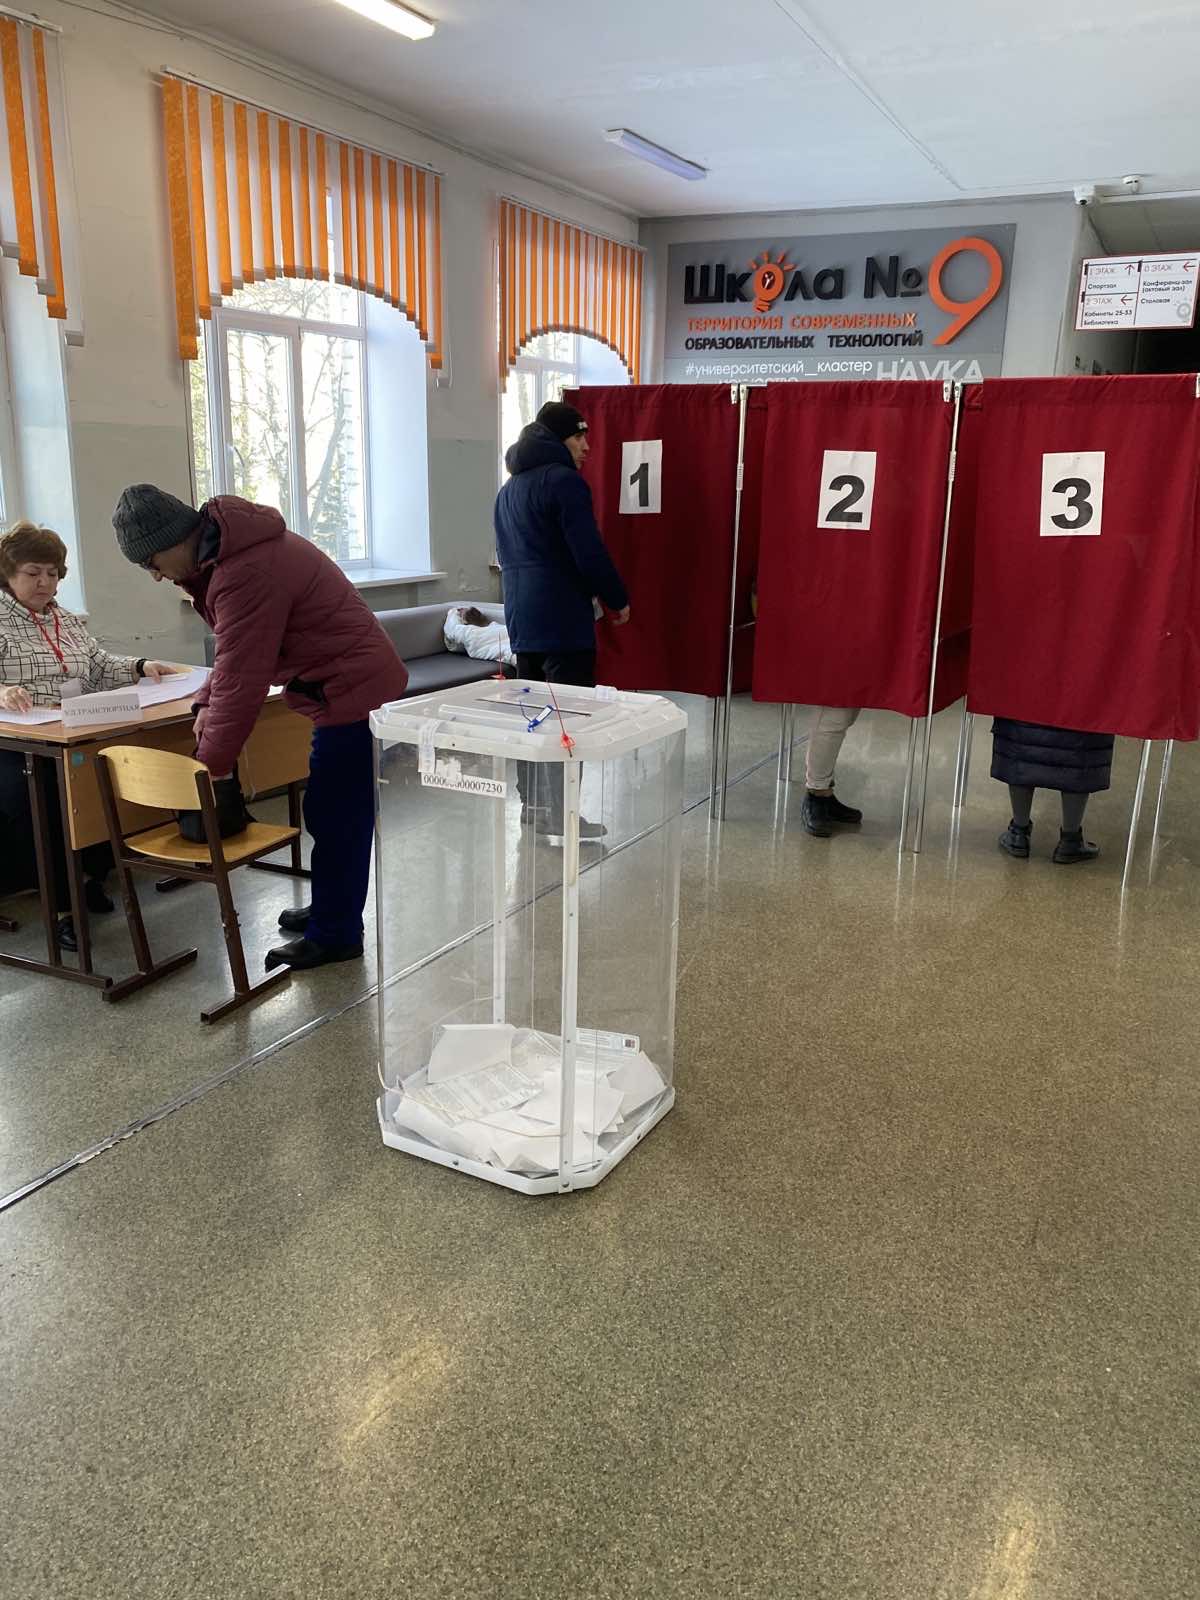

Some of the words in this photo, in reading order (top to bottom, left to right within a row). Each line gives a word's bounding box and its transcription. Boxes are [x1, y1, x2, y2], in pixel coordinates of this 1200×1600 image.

[684, 251, 844, 311] Школа
[685, 334, 815, 350] ОБРАЗОВАТЕЛЬНЫХ
[827, 330, 923, 349] ТЕХНОЛОГИЙ
[687, 316, 782, 332] ТЕРРИТОРИЯ
[791, 312, 917, 331] СОВРЕМЕННЫХ
[629, 462, 649, 508] 1
[825, 474, 866, 523] 2
[1050, 477, 1093, 529] 3
